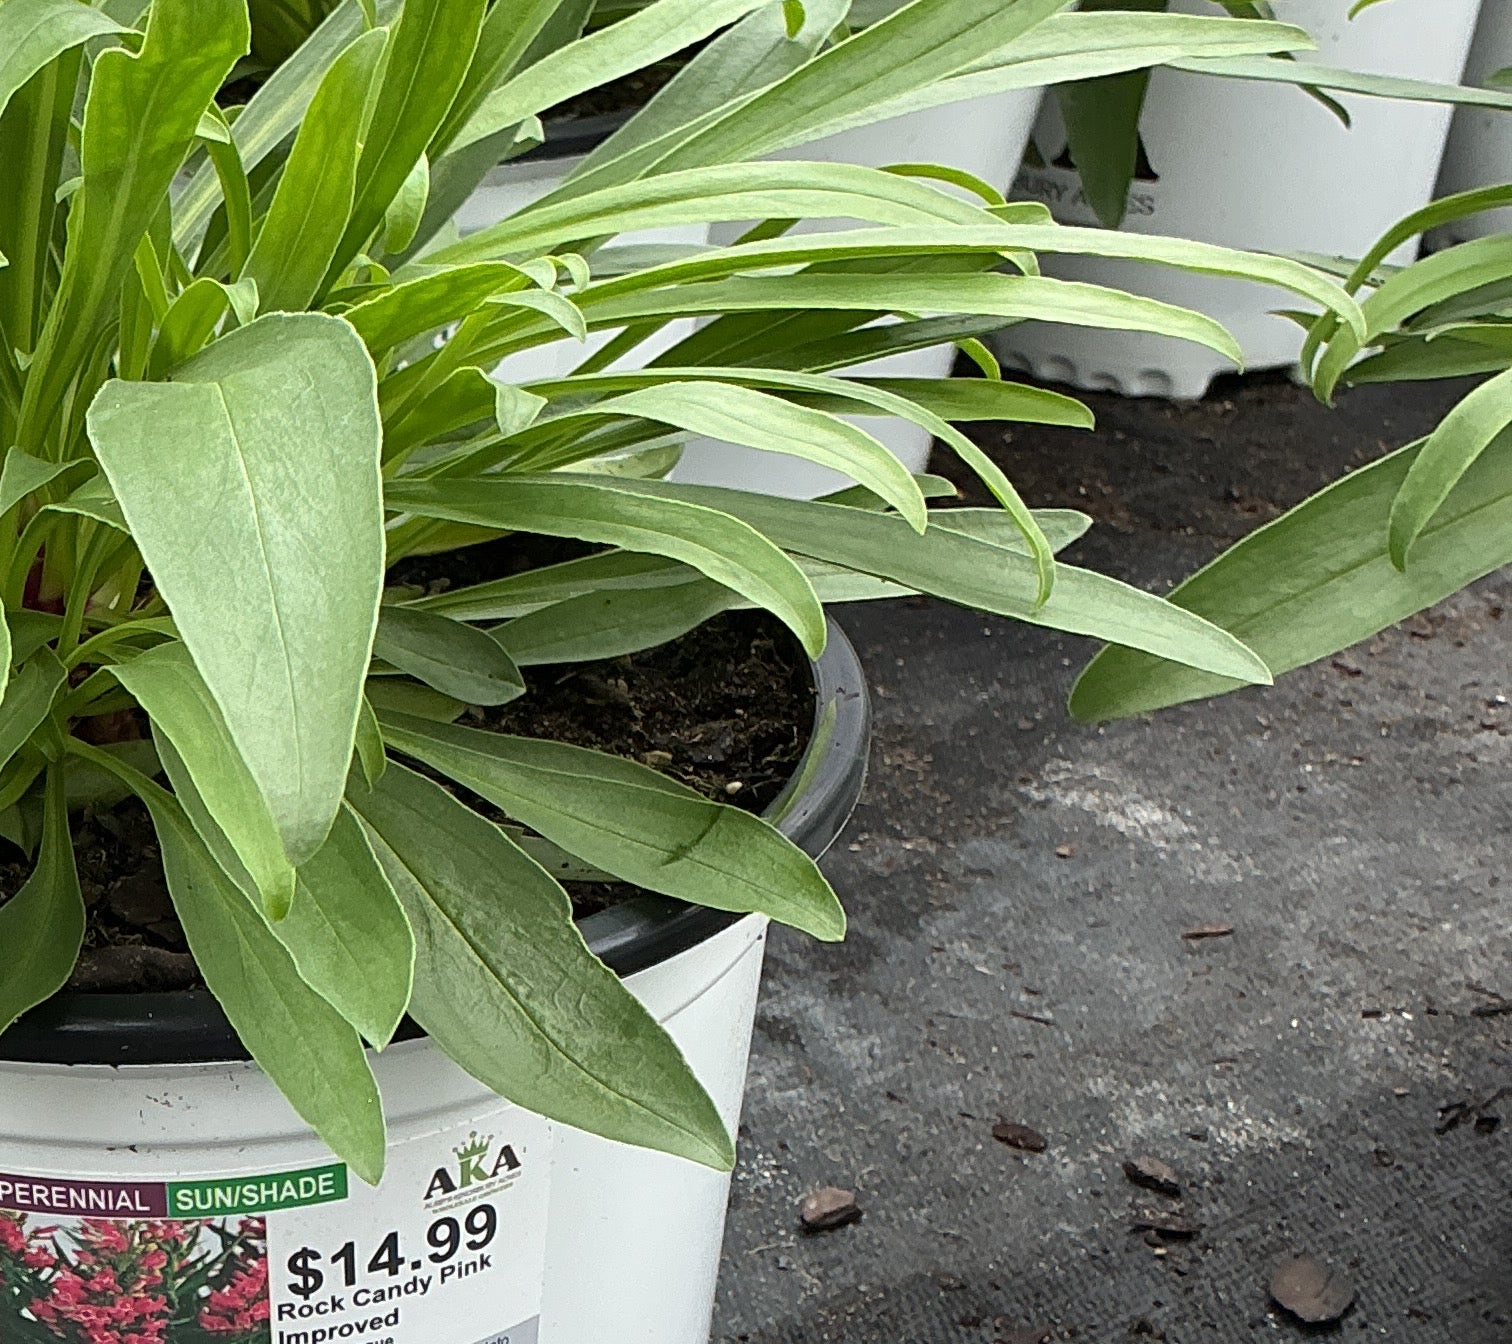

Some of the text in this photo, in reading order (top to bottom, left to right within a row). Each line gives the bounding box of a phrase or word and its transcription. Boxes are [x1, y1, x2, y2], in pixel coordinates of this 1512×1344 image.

[176, 1173, 335, 1211] SUN/SHADE
[423, 1143, 522, 1201] AKA
[287, 1204, 497, 1300] $14.99
[277, 1254, 492, 1321] Rock Candy Pink
